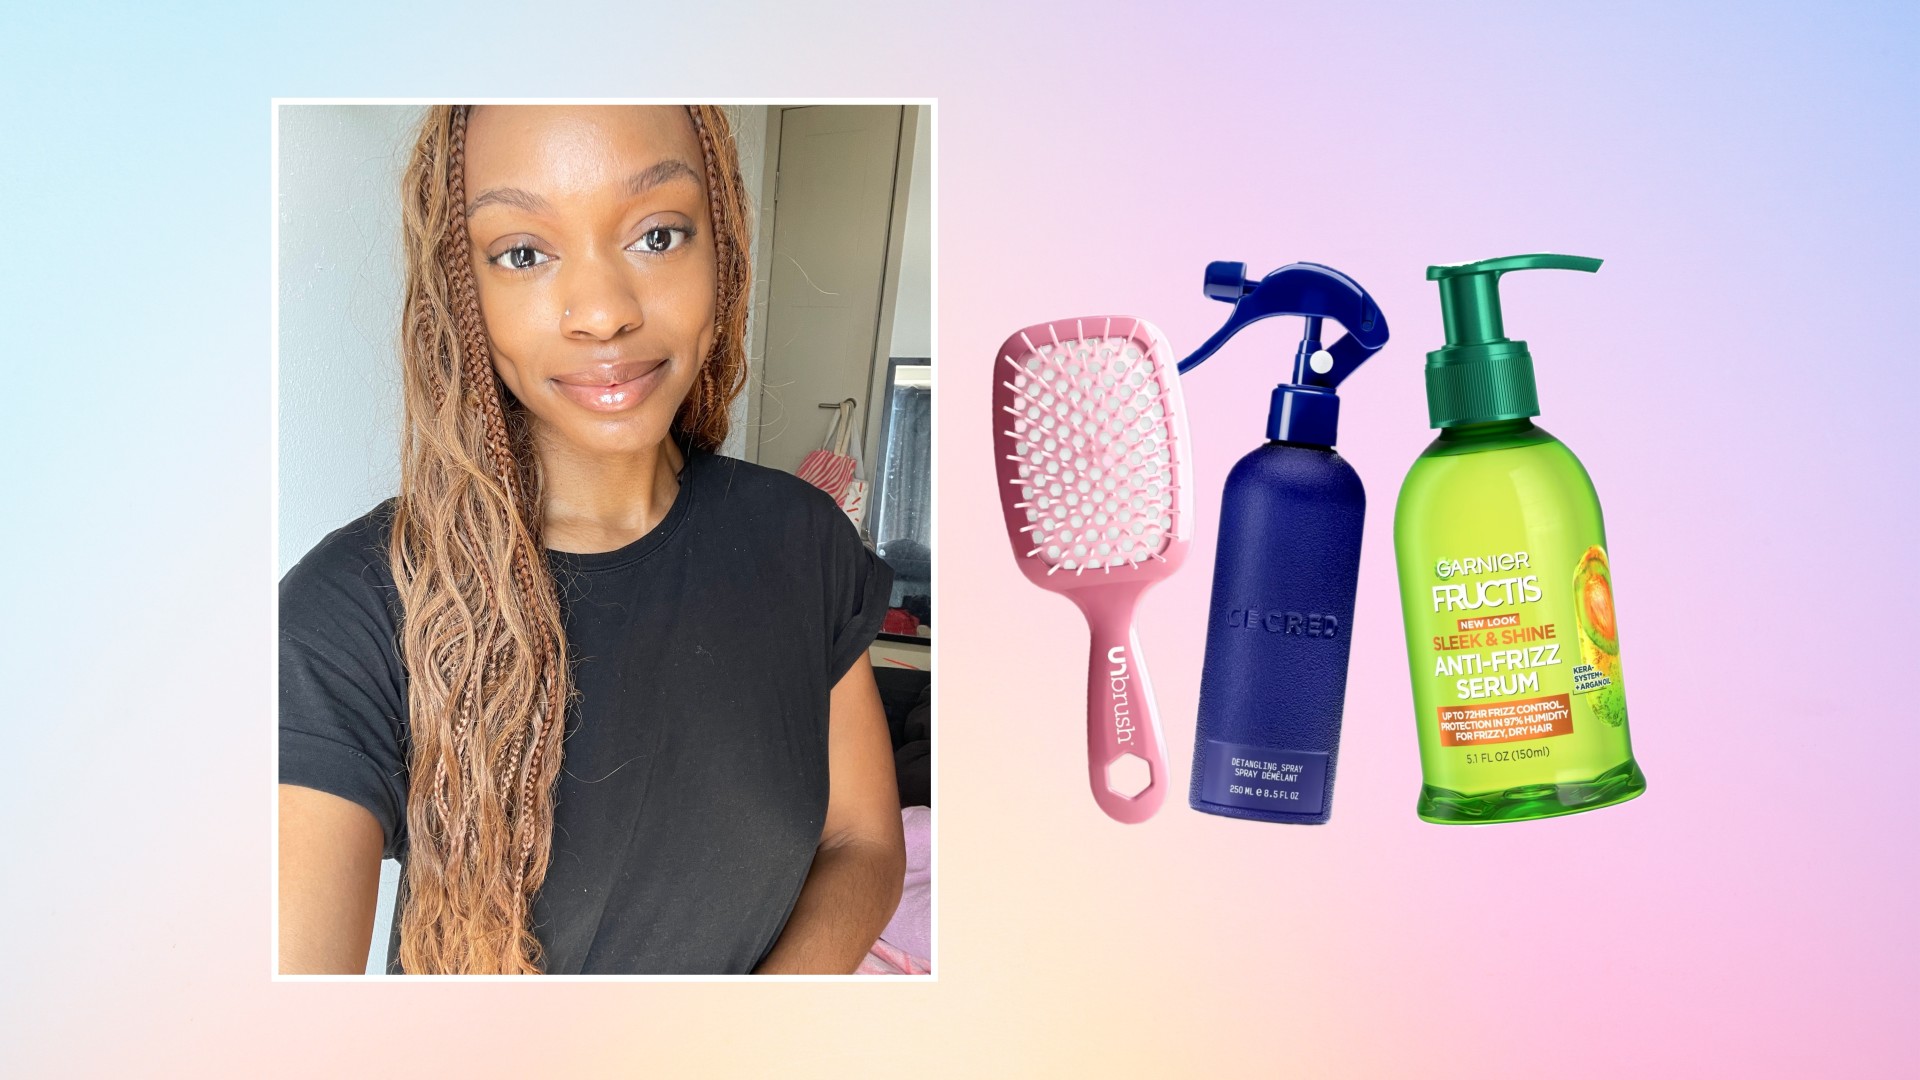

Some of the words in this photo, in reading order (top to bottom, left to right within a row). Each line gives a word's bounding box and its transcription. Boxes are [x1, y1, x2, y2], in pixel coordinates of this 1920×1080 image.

[1436, 551, 1531, 578] GARNIER
[1432, 575, 1543, 613] FRUCTIS
[1460, 619, 1485, 630] NEW
[1487, 615, 1517, 627] LOOK
[1433, 633, 1483, 651] SLEEK
[1485, 631, 1498, 646] &
[1501, 624, 1556, 645] SHINE
[1434, 643, 1562, 677] ANTI-FRIZZ
[1573, 664, 1594, 675] KERA-
[1107, 646, 1136, 744] unbrush
[1456, 671, 1540, 700] SERUM
[1441, 720, 1492, 731] PROTECTION
[1493, 720, 1503, 728] IN
[1504, 717, 1523, 726] 97%
[1524, 710, 1569, 724] HUMIDITY
[1442, 711, 1453, 721] UP
[1453, 710, 1464, 720] TO
[1465, 709, 1488, 719] 72HR
[1488, 707, 1515, 717] FRIZZ
[1516, 701, 1565, 715] CONTROL.
[1456, 732, 1473, 741] FOR
[1473, 729, 1508, 740] FRIZZY,
[1508, 726, 1528, 736] DRY
[1529, 723, 1553, 734] HAIR
[1231, 757, 1277, 771] DETANGLING
[1281, 763, 1303, 773] SPRAY
[1466, 754, 1478, 764] 5.1
[1481, 753, 1493, 763] FL
[1495, 751, 1510, 762] OZ
[1511, 746, 1550, 762] (150ml)
[1235, 768, 1258, 778] SPRAY
[1229, 784, 1244, 794] 250
[1245, 786, 1254, 795] ML
[1264, 789, 1278, 798] 8.5
[1280, 790, 1289, 799] FL
